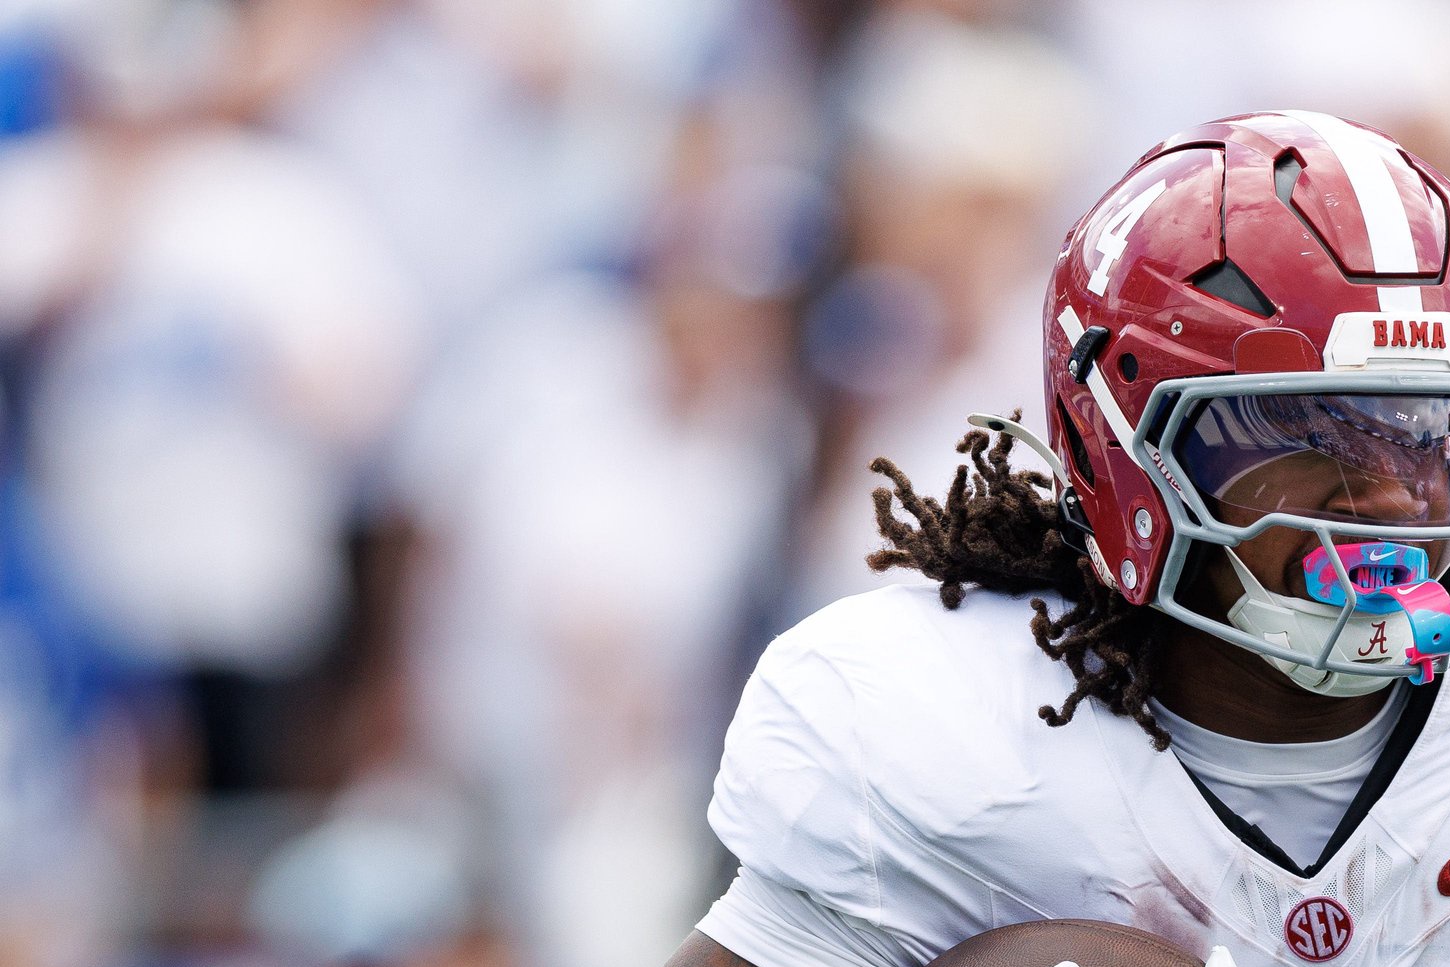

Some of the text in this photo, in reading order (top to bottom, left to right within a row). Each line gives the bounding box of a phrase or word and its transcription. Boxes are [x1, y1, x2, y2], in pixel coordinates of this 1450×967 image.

[1087, 178, 1166, 297] 4
[1373, 320, 1446, 349] BAMA
[1357, 566, 1395, 590] NIKE
[1358, 620, 1388, 656] A
[1290, 902, 1348, 957] SEC
